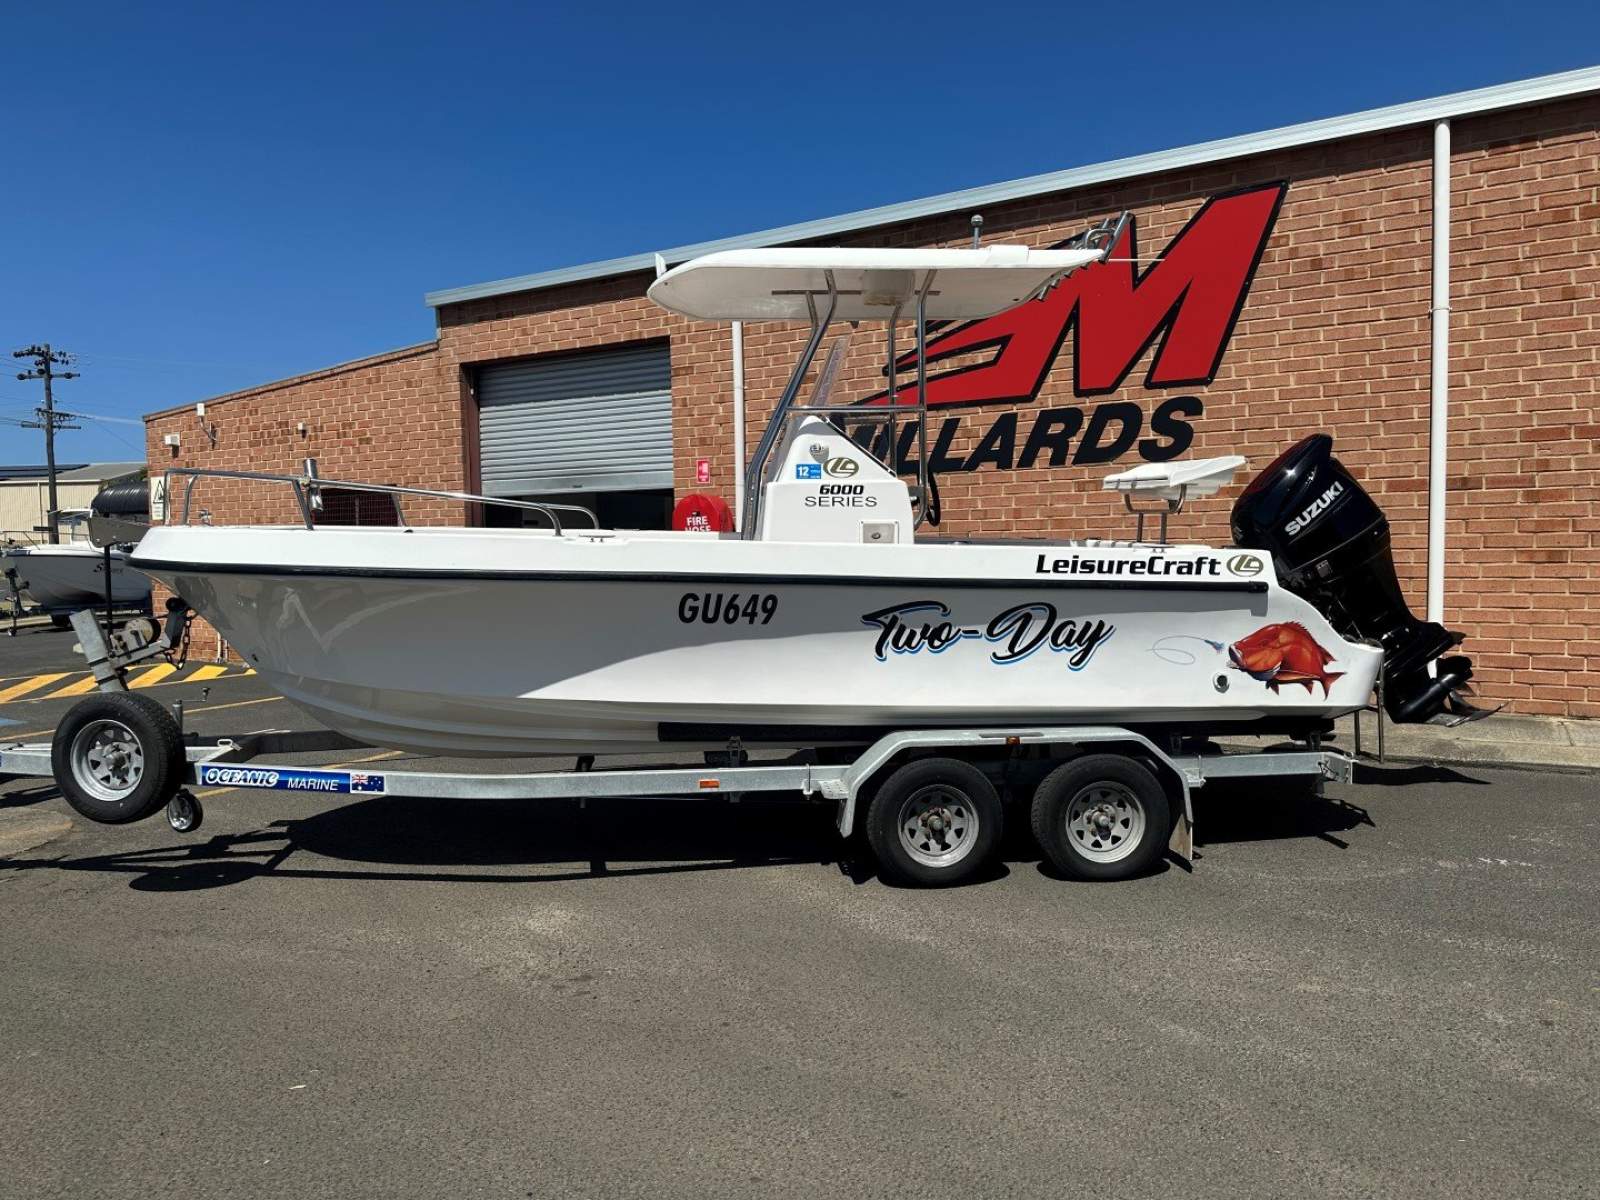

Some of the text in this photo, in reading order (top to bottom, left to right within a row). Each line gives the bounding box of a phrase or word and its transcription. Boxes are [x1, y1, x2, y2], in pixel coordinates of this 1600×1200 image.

[797, 466, 810, 477] 12
[819, 484, 864, 495] 6000
[804, 496, 877, 507] SERIES
[1284, 480, 1345, 536] SUZUKI
[686, 515, 709, 526] FIRE
[1035, 554, 1222, 576] LeisureCraft
[677, 592, 779, 625] GU649
[860, 600, 1116, 671] Two-Day
[205, 768, 339, 791] OCEANIC MARINE
